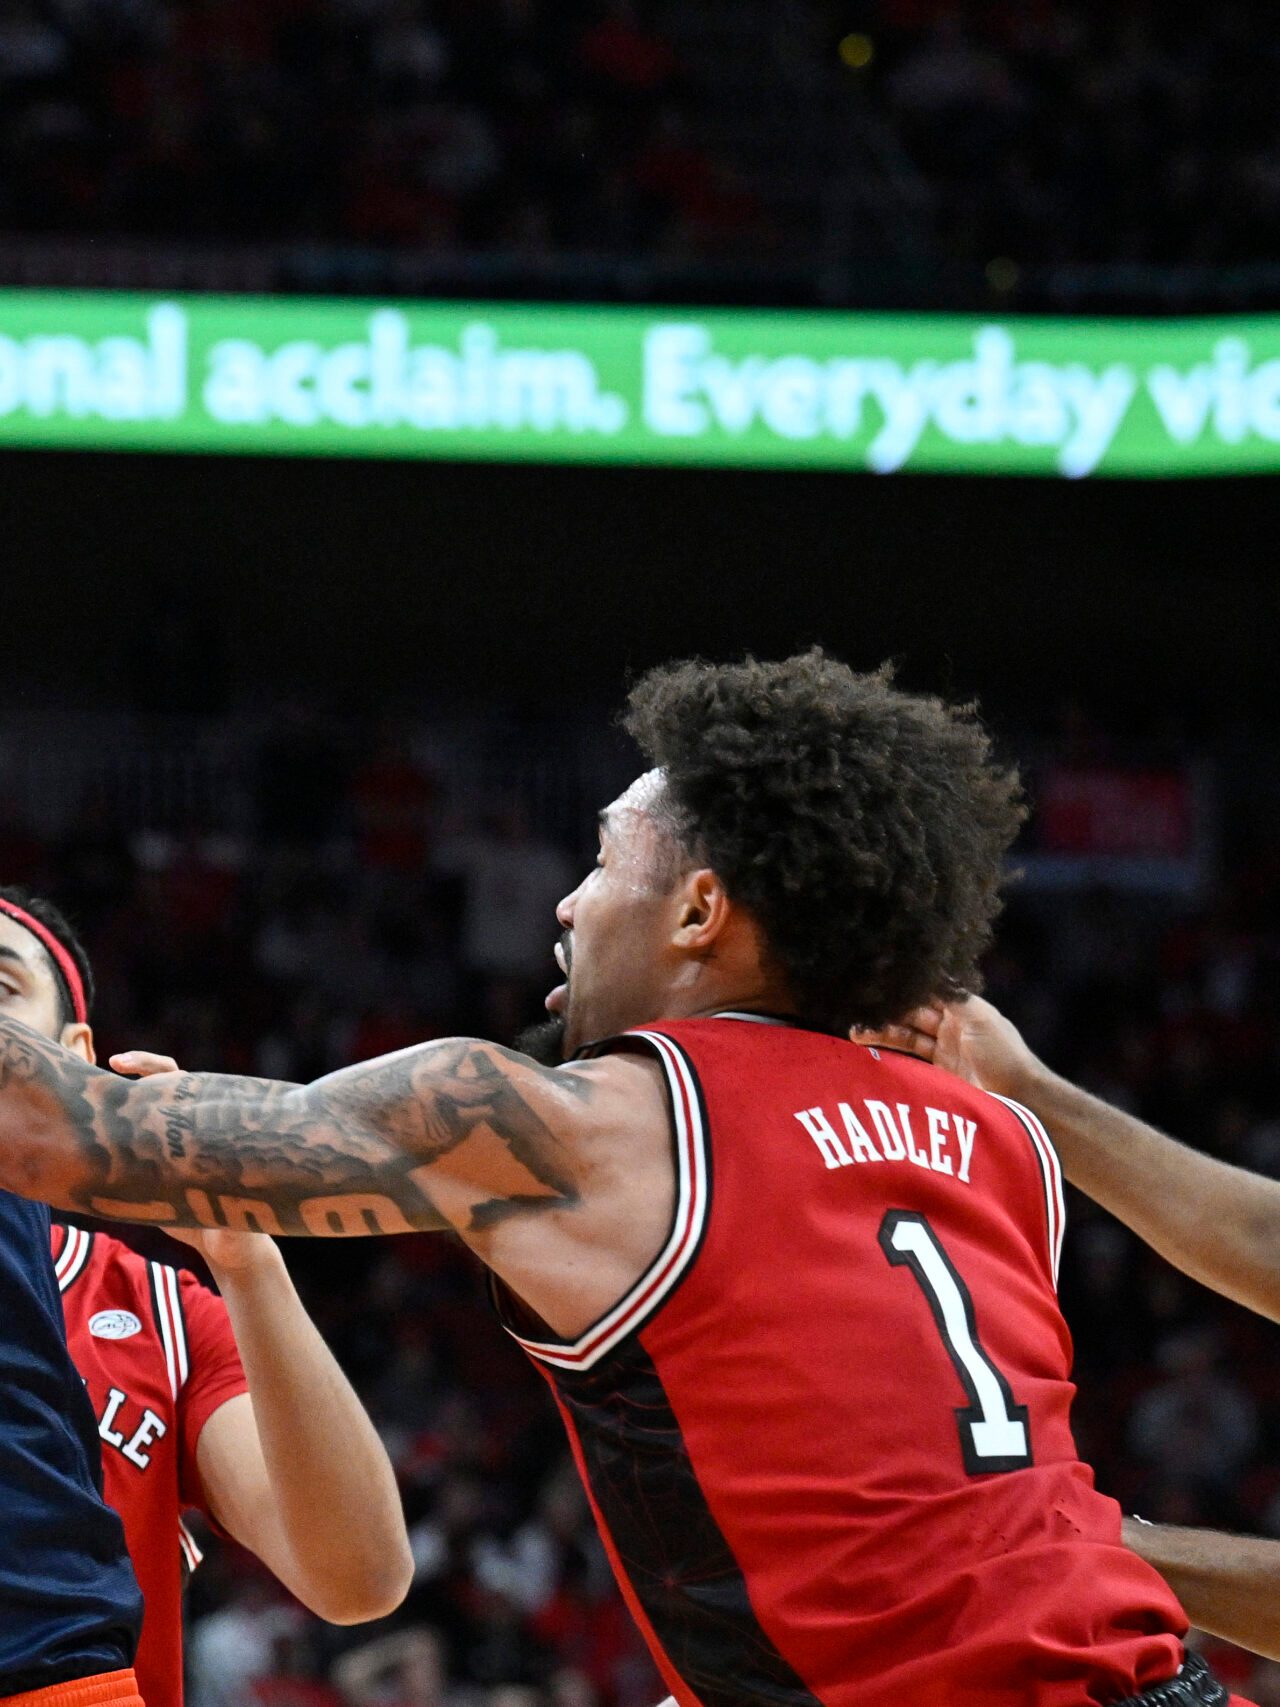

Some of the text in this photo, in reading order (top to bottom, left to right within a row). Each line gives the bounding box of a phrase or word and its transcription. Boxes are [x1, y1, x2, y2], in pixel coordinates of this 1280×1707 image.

[204, 308, 626, 435] acclaim.
[642, 323, 1135, 478] Everyday
[793, 1099, 978, 1184] HADLEY
[878, 1208, 1034, 1476] 1
[82, 1377, 167, 1470] LE
